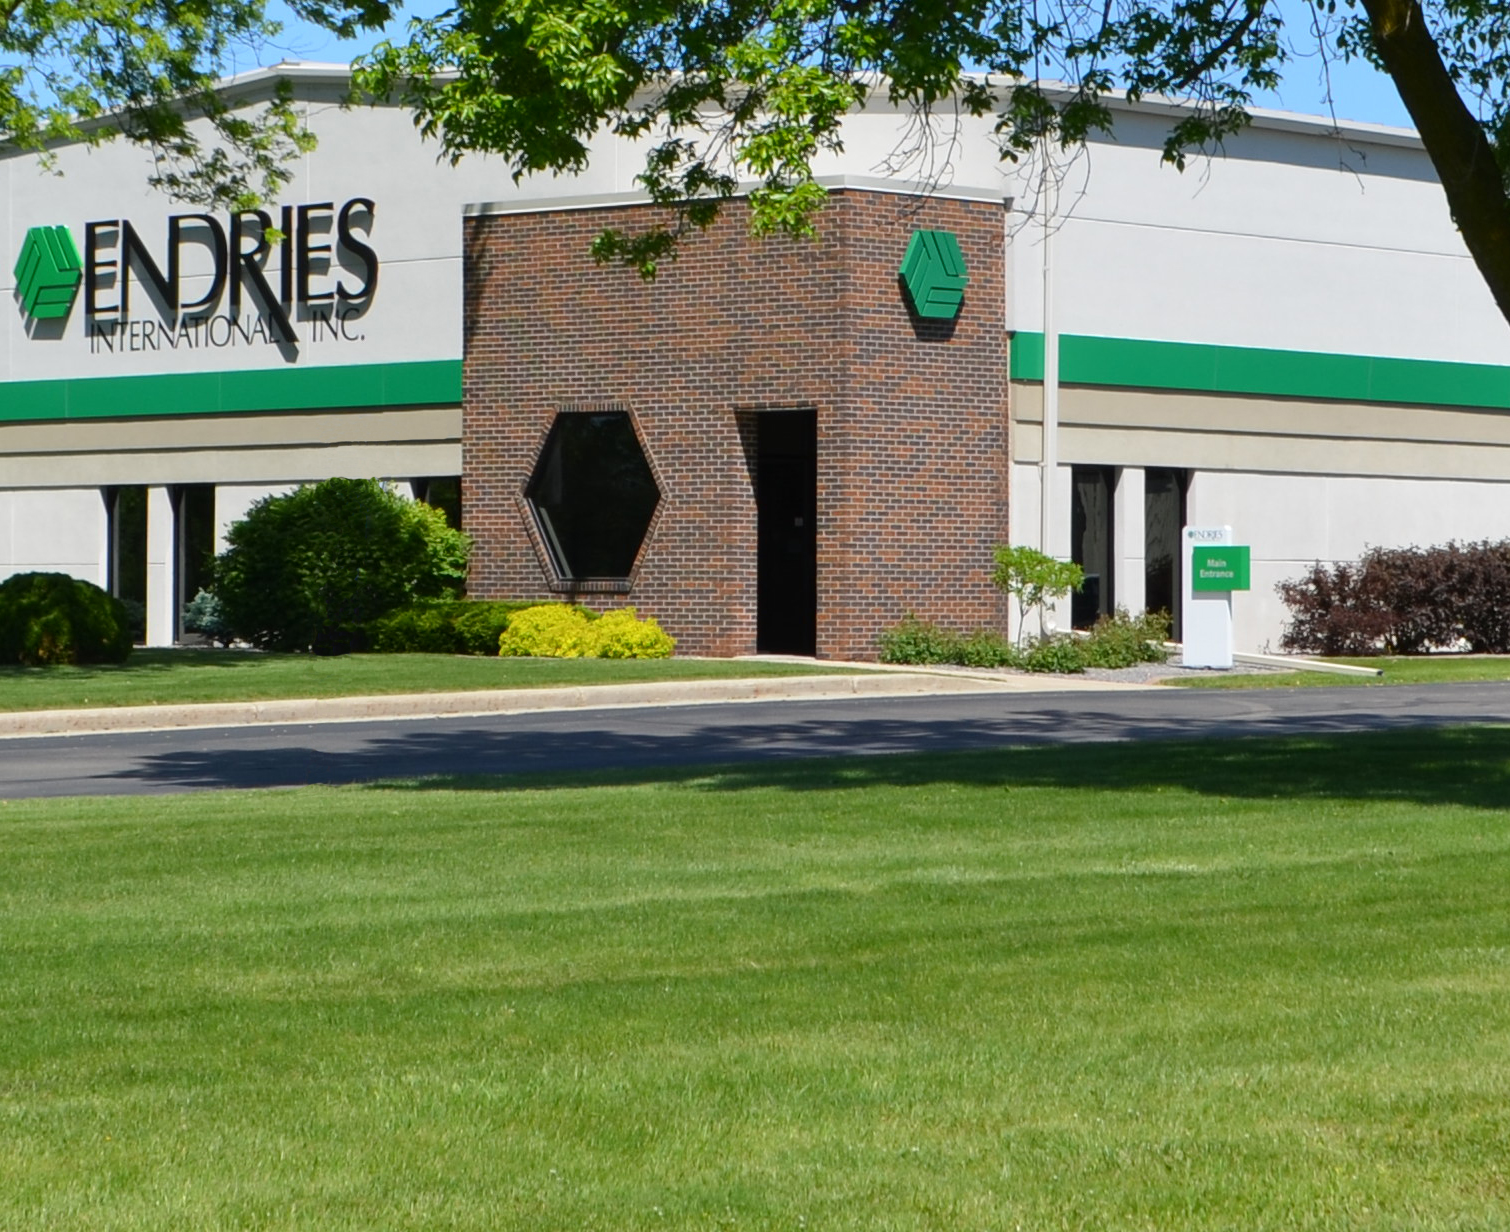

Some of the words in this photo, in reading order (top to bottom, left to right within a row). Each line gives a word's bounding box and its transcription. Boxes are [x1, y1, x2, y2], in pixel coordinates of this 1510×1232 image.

[85, 197, 379, 343] ENDRIES
[90, 314, 280, 354] INTERNATIONAL
[312, 308, 366, 343] INC.
[1200, 569, 1234, 578] Entrance
[1207, 559, 1227, 567] Main
